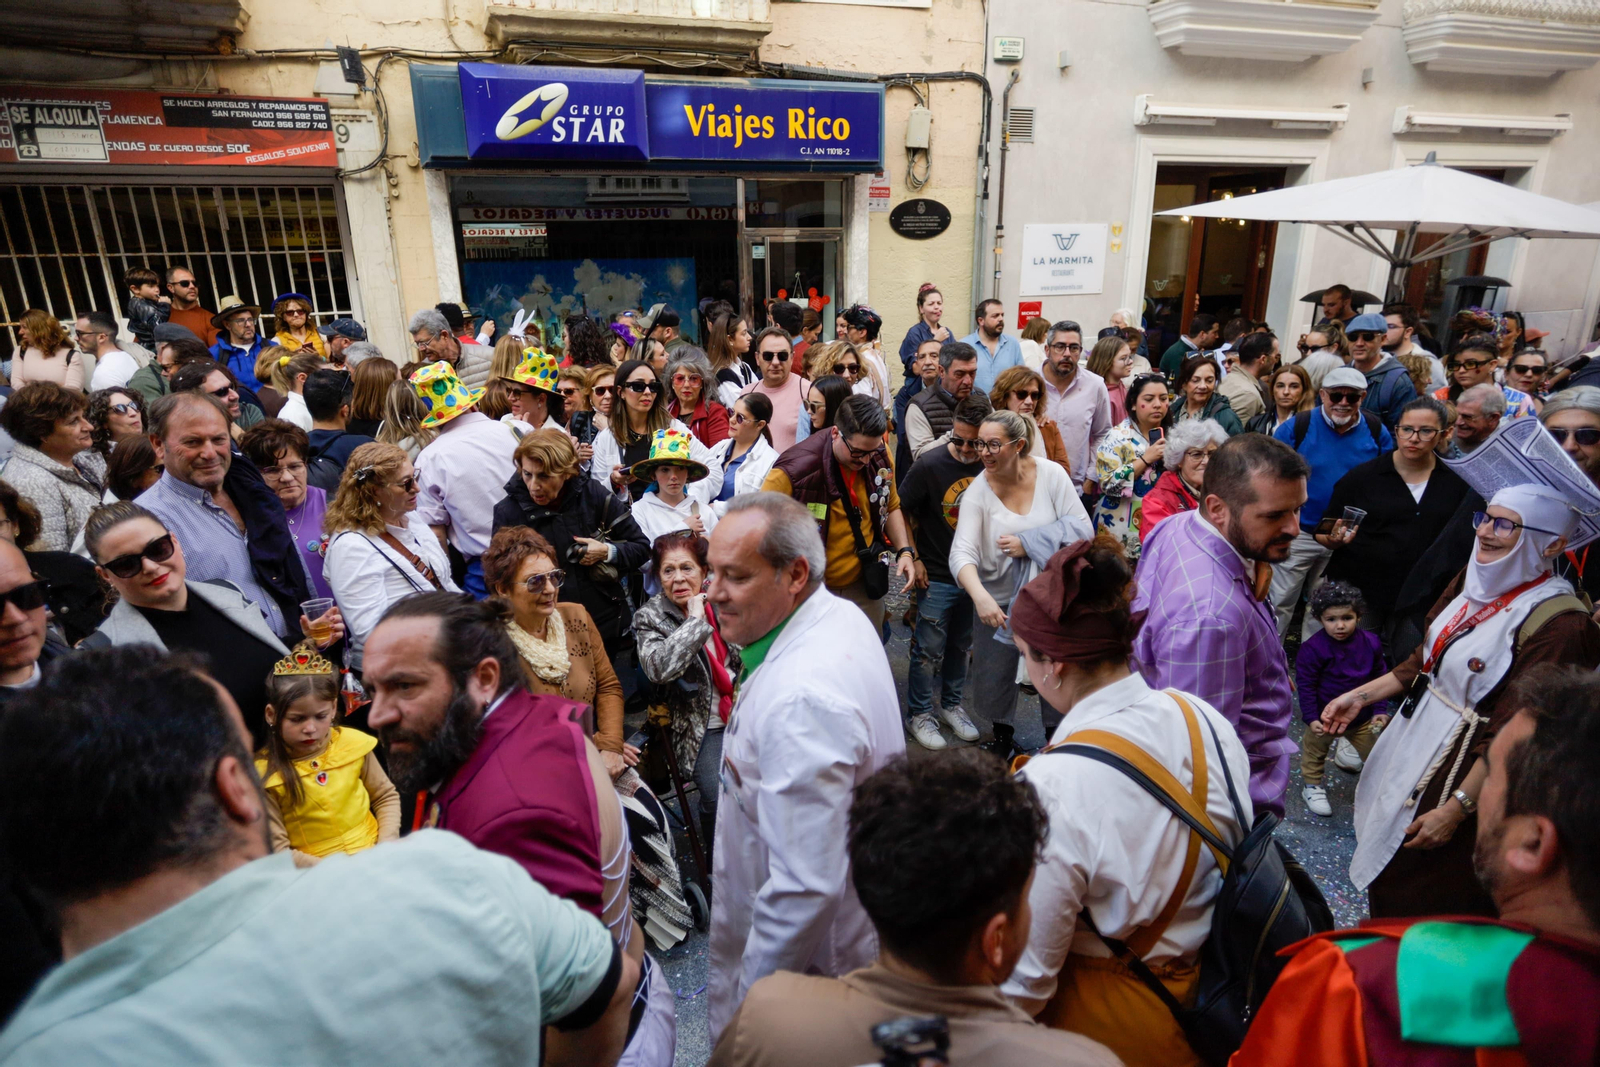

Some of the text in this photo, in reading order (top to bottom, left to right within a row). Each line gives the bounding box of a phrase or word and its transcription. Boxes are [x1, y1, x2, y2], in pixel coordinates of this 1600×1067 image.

[176, 100, 205, 108] HACEN
[207, 101, 250, 109] ARREGLOS
[258, 103, 307, 111] REPARAMOS
[570, 104, 624, 116] GRUPO
[9, 106, 31, 124] SE
[34, 107, 98, 126] ALQUILA
[100, 115, 163, 125] FLAMENCA
[552, 116, 625, 143] STAR
[683, 103, 851, 148] Viajes Rico
[336, 124, 350, 143] 9
[106, 142, 146, 151] ENDAS
[149, 144, 162, 152] DE
[164, 145, 194, 153] CUERO
[195, 145, 224, 153] DESDE
[245, 142, 330, 164] REGALOS SOUVENIR
[814, 147, 825, 155] AN
[826, 147, 850, 156] 11018-2
[1033, 256, 1093, 265] LA MARMITA
